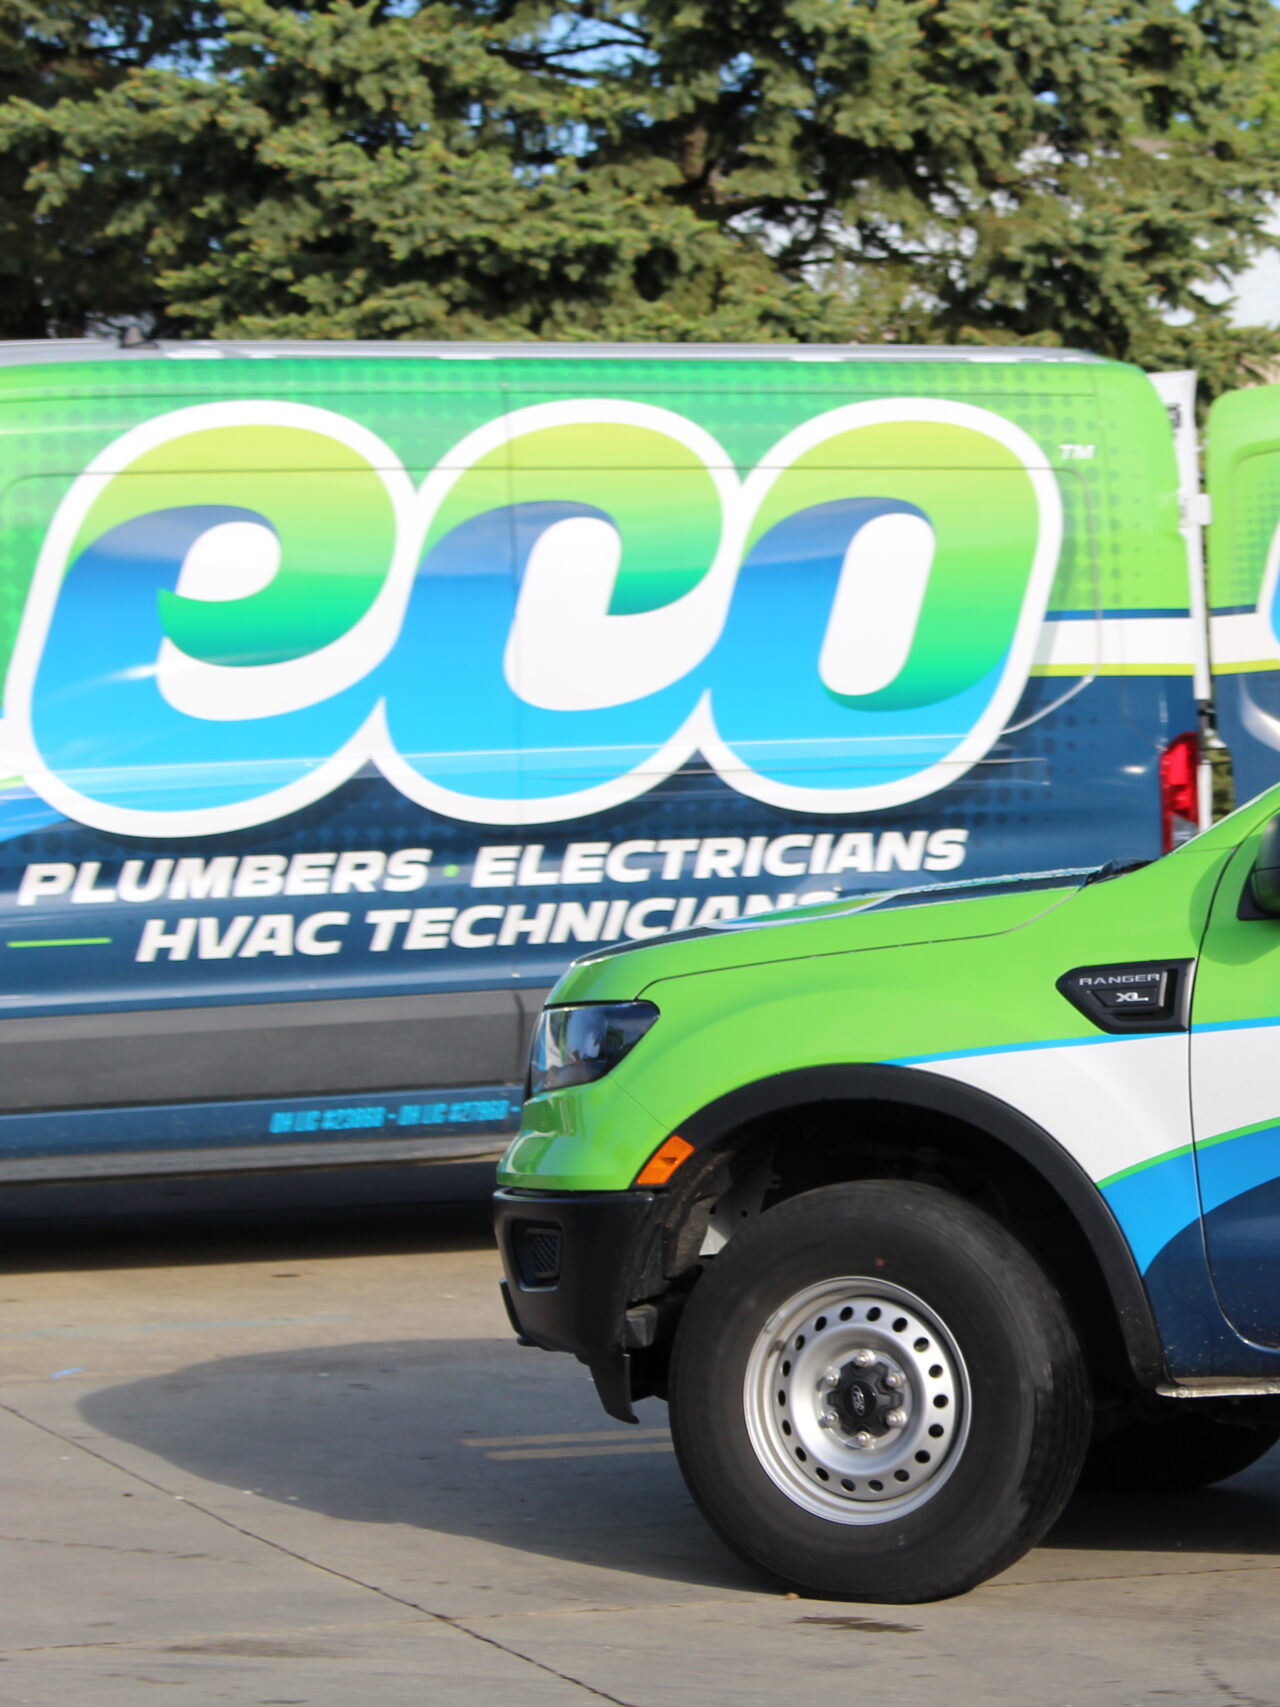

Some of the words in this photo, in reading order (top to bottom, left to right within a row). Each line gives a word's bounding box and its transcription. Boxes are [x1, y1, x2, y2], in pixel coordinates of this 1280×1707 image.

[5, 398, 1063, 838] eco
[16, 848, 432, 907] PLUMBERS
[470, 828, 968, 888] ELECTRICIANS
[136, 911, 350, 962] HVAC
[1078, 973, 1161, 986] RANGER
[1115, 991, 1150, 1003] XL
